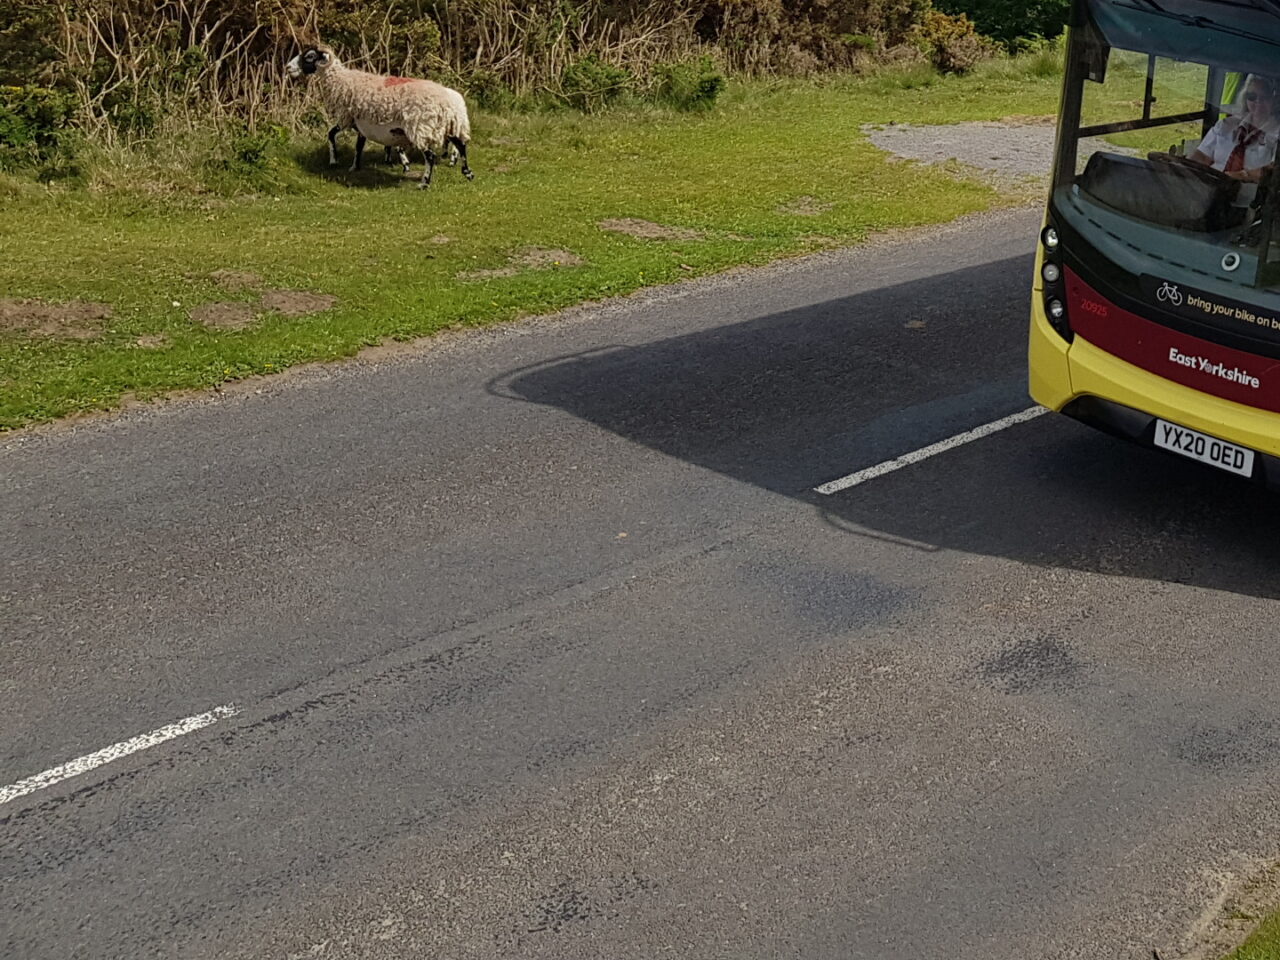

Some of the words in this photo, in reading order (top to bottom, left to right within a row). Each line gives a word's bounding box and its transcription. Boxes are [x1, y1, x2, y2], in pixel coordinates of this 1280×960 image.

[1081, 299, 1108, 317] 20925
[1187, 295, 1212, 312] bring
[1212, 303, 1235, 316] your
[1235, 308, 1256, 323] bike
[1257, 316, 1270, 327] on
[1169, 347, 1197, 369] East
[1198, 356, 1260, 389] Yorkshire
[1163, 424, 1206, 457] YX20
[1210, 442, 1245, 470] OED
